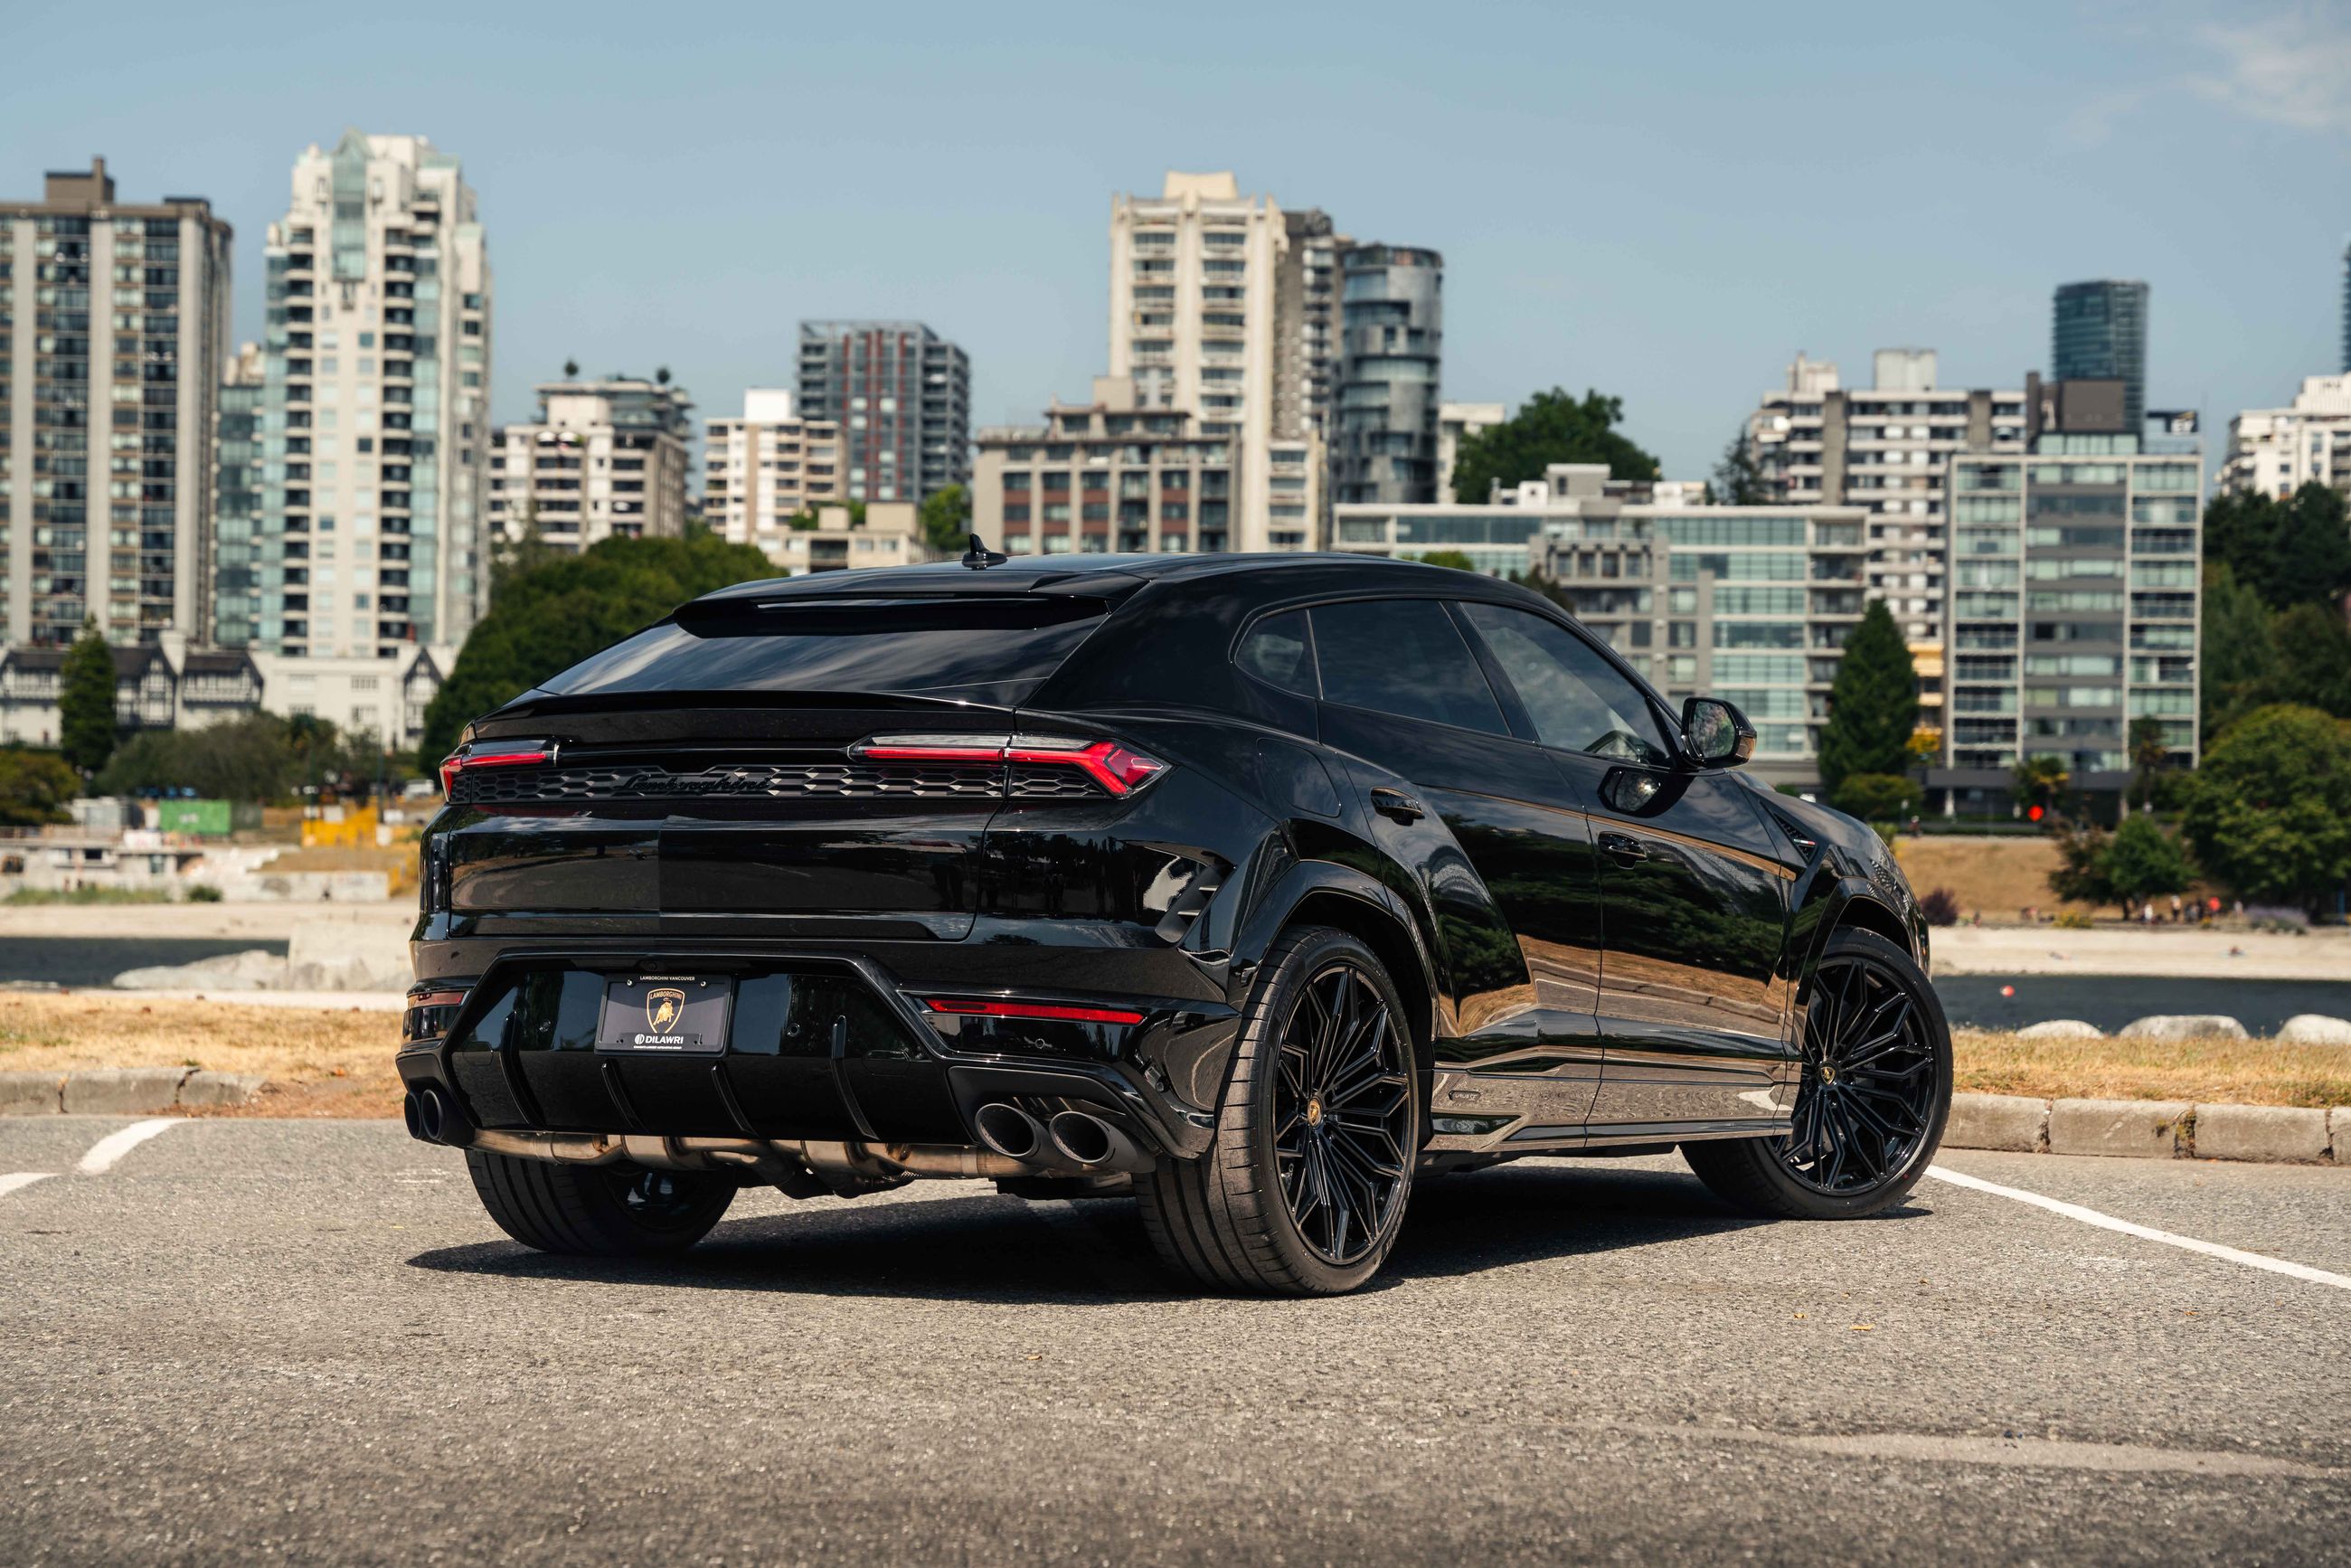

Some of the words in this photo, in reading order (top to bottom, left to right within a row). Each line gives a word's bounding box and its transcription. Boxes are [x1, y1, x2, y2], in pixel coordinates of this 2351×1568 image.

[623, 774, 773, 792] Lamborghini
[649, 990, 683, 999] LAMBORGHINI
[645, 1035, 684, 1044] DILAWRI
